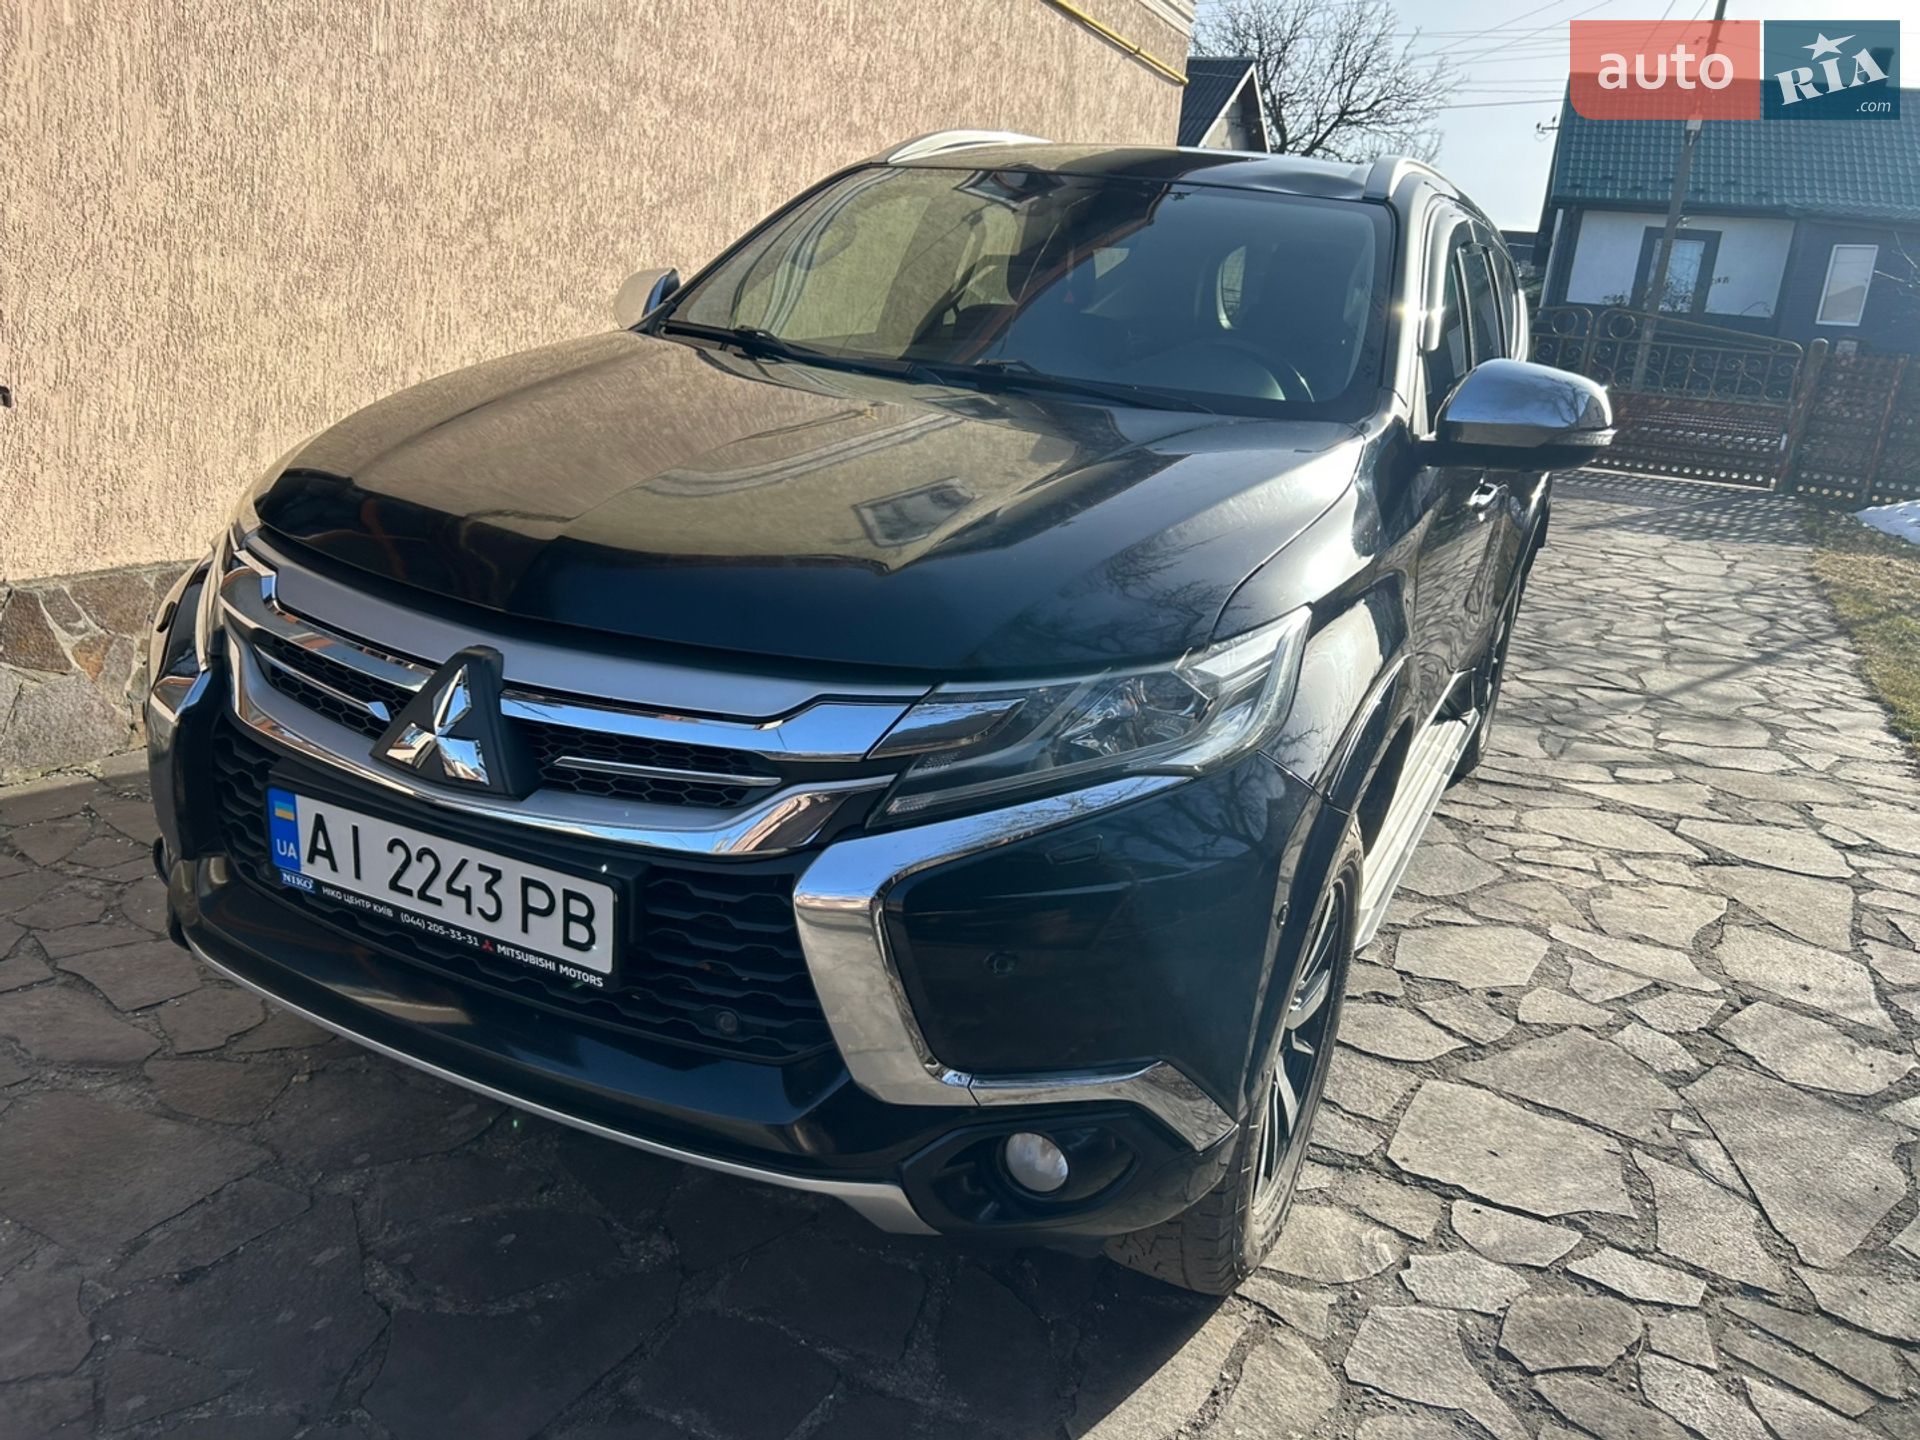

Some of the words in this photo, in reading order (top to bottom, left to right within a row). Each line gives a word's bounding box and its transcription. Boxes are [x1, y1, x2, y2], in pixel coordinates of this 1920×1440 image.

[276, 838, 298, 860] UA
[283, 872, 313, 890] NIKO
[306, 812, 362, 881] AI
[386, 837, 503, 923] 2243
[520, 876, 597, 953] PB
[343, 894, 371, 909] ЦЕНТР
[400, 912, 425, 930] (044)
[427, 920, 479, 946] 205-33-31
[497, 944, 555, 971] MITSUBISHI
[559, 964, 604, 988] MOTORS
